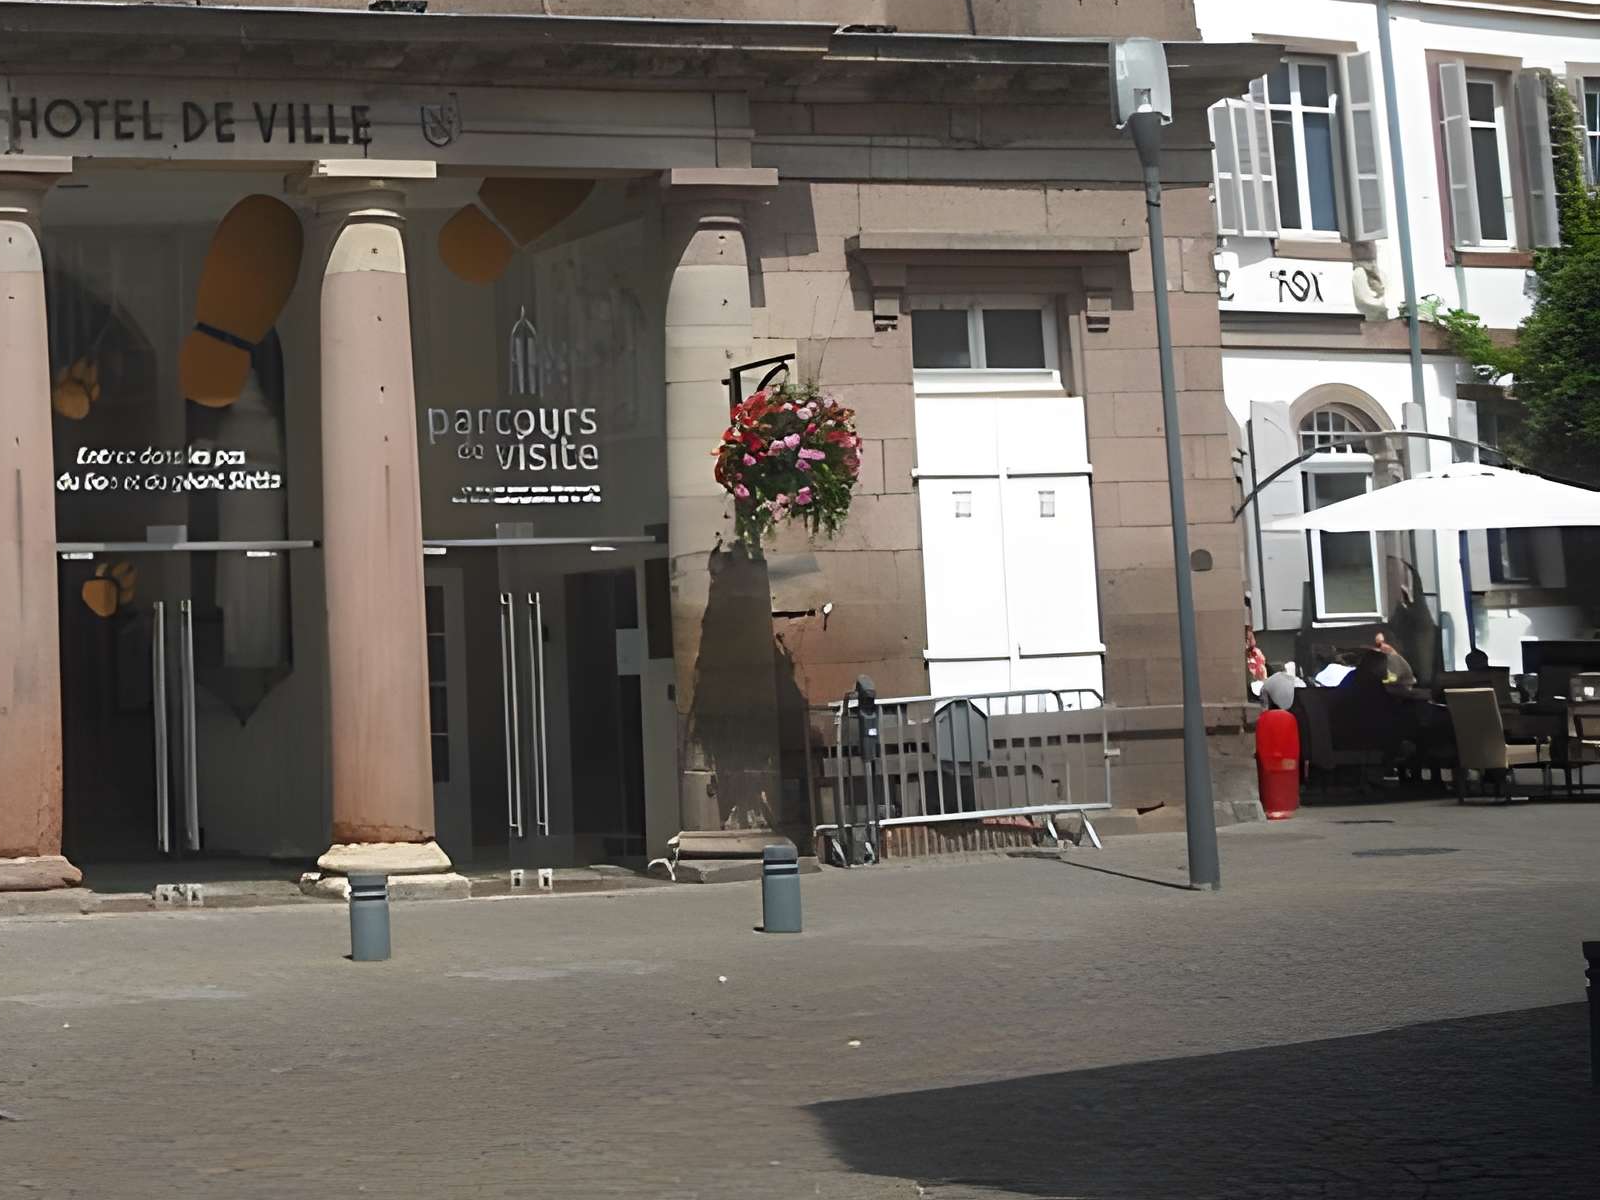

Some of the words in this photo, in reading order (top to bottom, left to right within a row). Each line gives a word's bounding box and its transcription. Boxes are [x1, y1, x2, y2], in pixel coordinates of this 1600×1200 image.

[11, 97, 162, 141] HOTEL
[183, 101, 236, 143] DE
[254, 103, 372, 145] VILLE
[428, 408, 598, 445] parcours
[496, 436, 599, 471] visite
